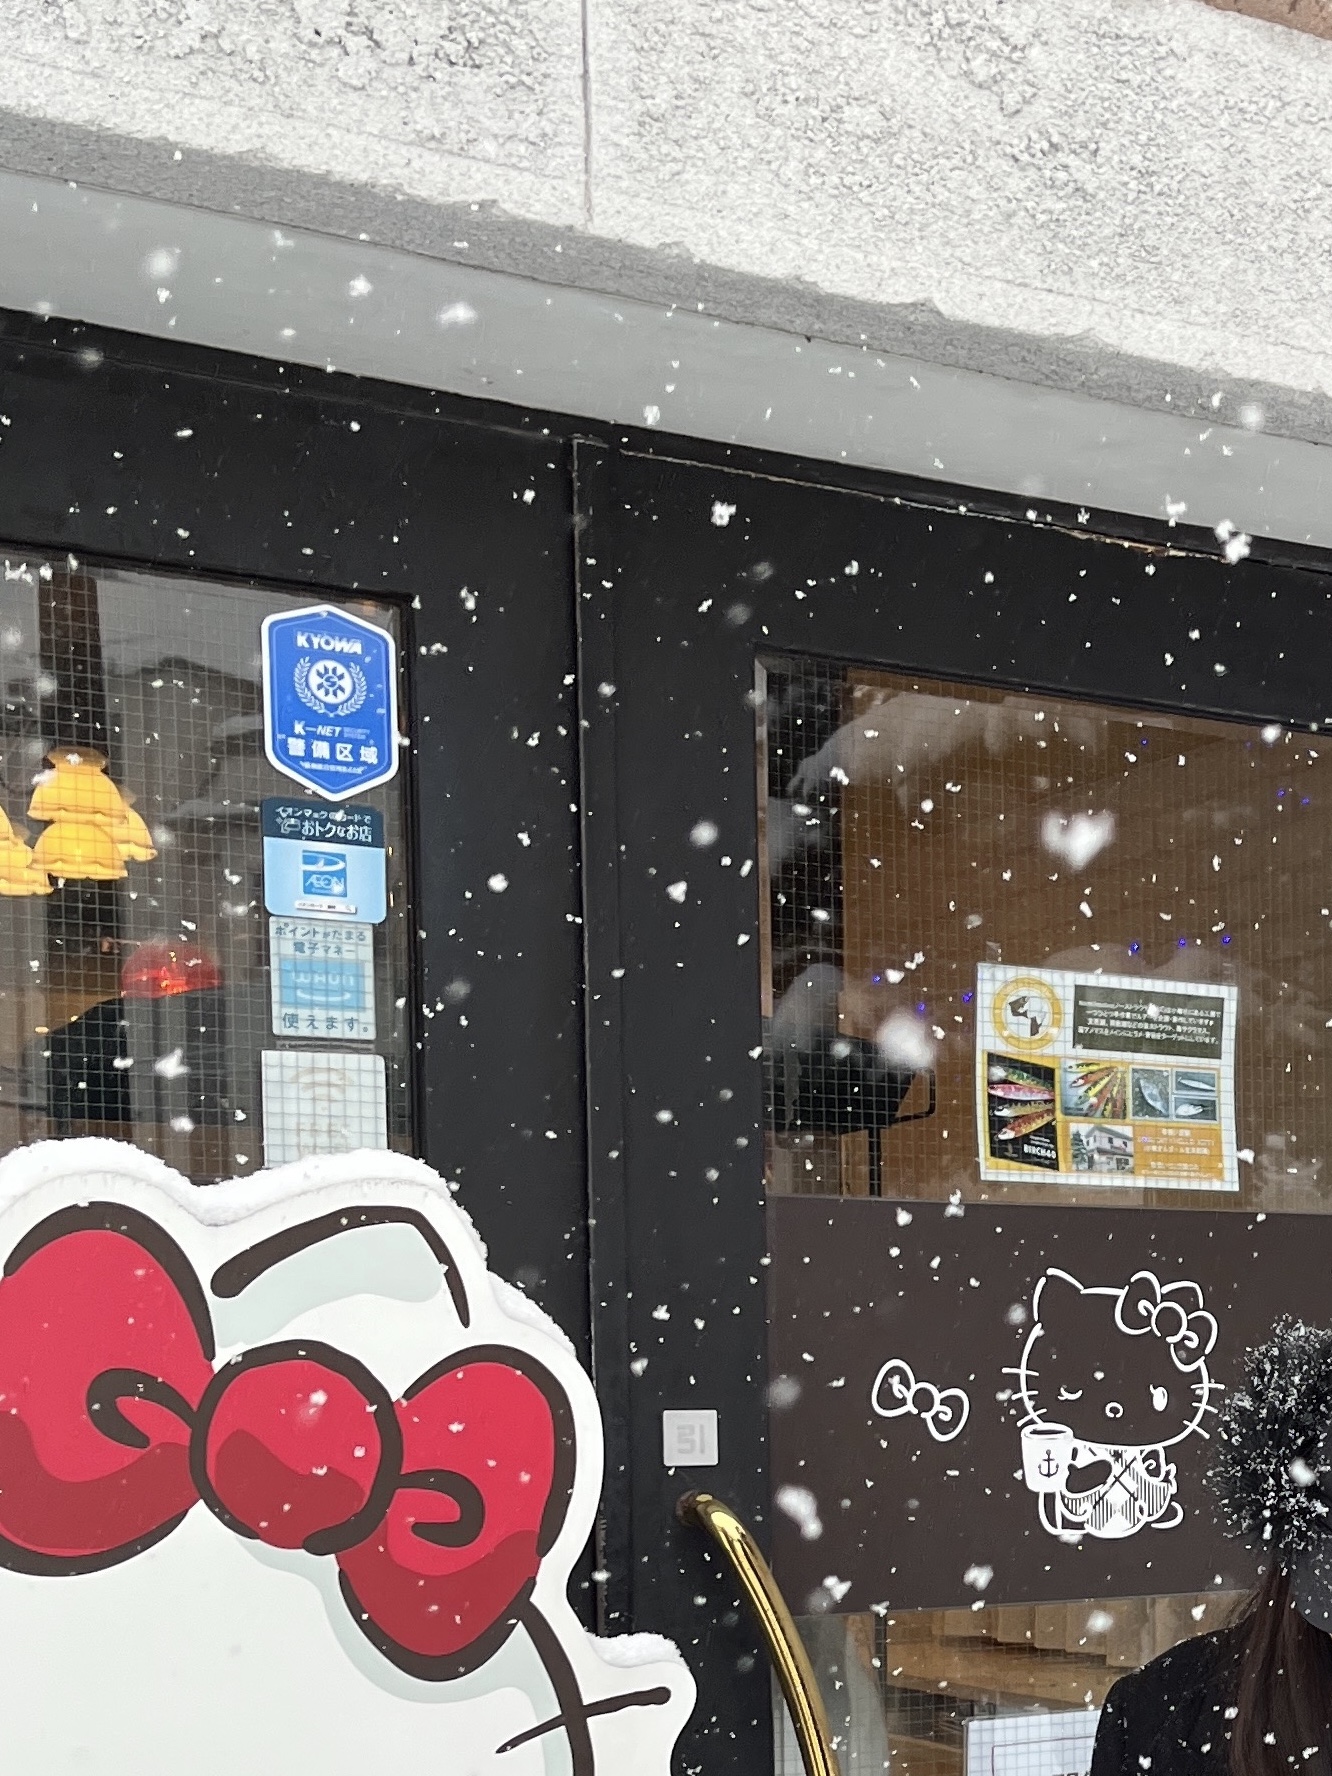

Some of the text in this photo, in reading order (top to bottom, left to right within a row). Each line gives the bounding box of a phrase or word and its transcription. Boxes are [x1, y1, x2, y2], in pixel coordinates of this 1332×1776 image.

[297, 631, 362, 655] KYOWA
[287, 736, 378, 765] 警備区域
[301, 820, 372, 842] おトクなお店
[275, 922, 366, 942] ポイントがたまる
[293, 941, 356, 956] 電子マネー
[282, 1012, 369, 1033] 使えます。
